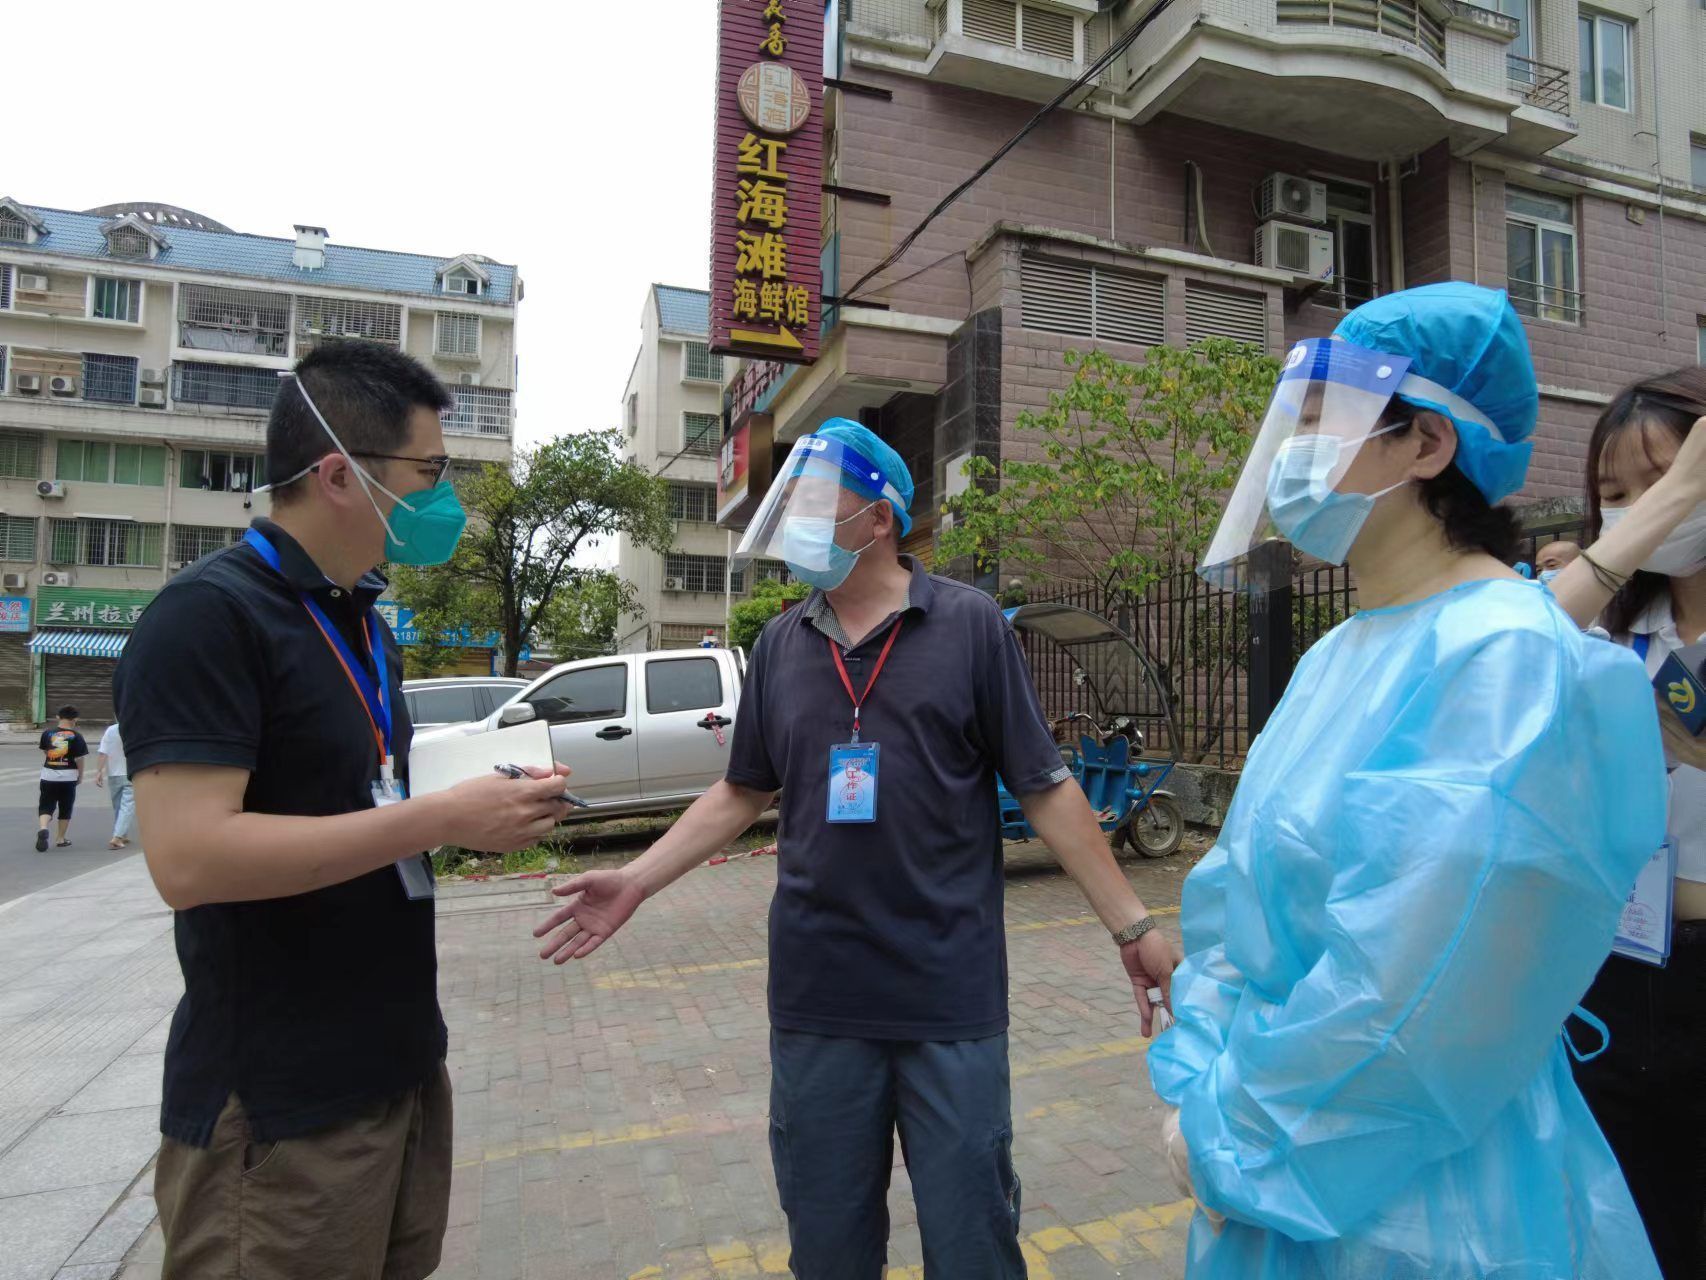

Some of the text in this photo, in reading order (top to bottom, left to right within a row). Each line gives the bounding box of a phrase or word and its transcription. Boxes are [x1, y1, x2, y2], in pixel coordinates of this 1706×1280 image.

[736, 133, 788, 279] 红海滩
[733, 279, 809, 325] 海鲜馆
